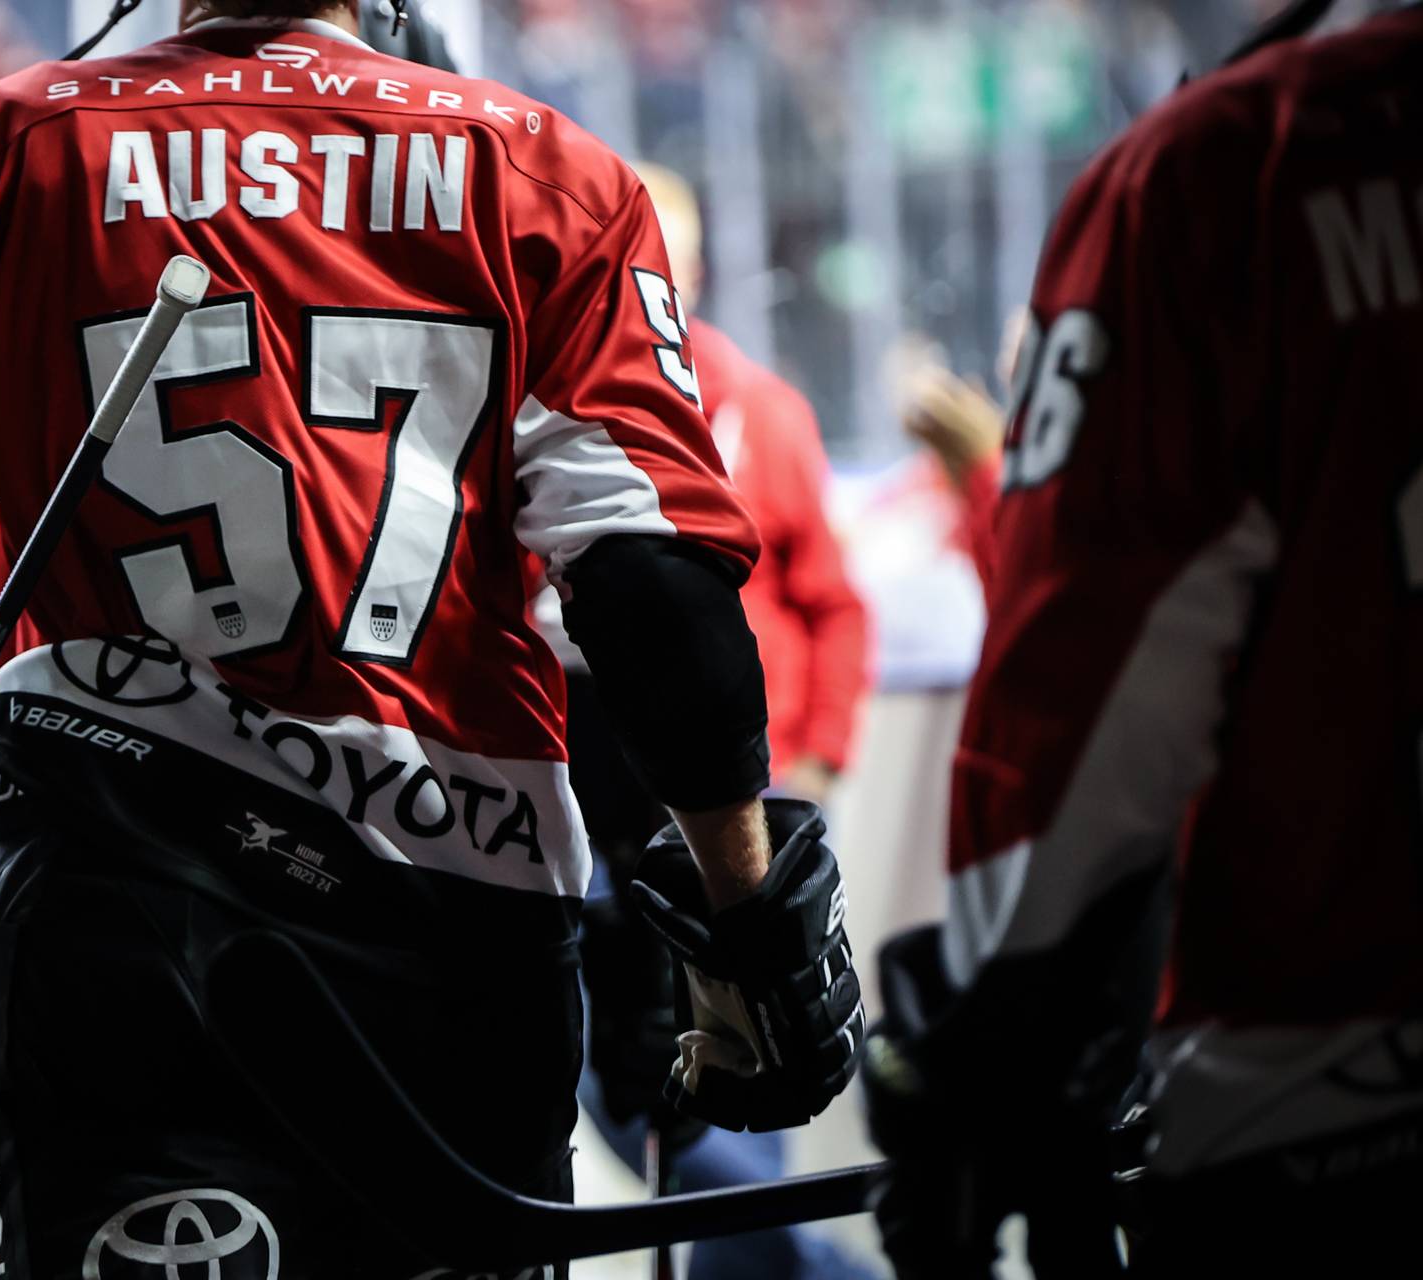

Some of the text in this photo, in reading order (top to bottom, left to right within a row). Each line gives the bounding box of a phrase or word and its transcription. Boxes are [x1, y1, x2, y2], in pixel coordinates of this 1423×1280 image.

[103, 127, 468, 233] AUSTIN
[79, 291, 507, 668] 57
[216, 683, 544, 864] TOYOTA
[294, 842, 326, 867] HOME
